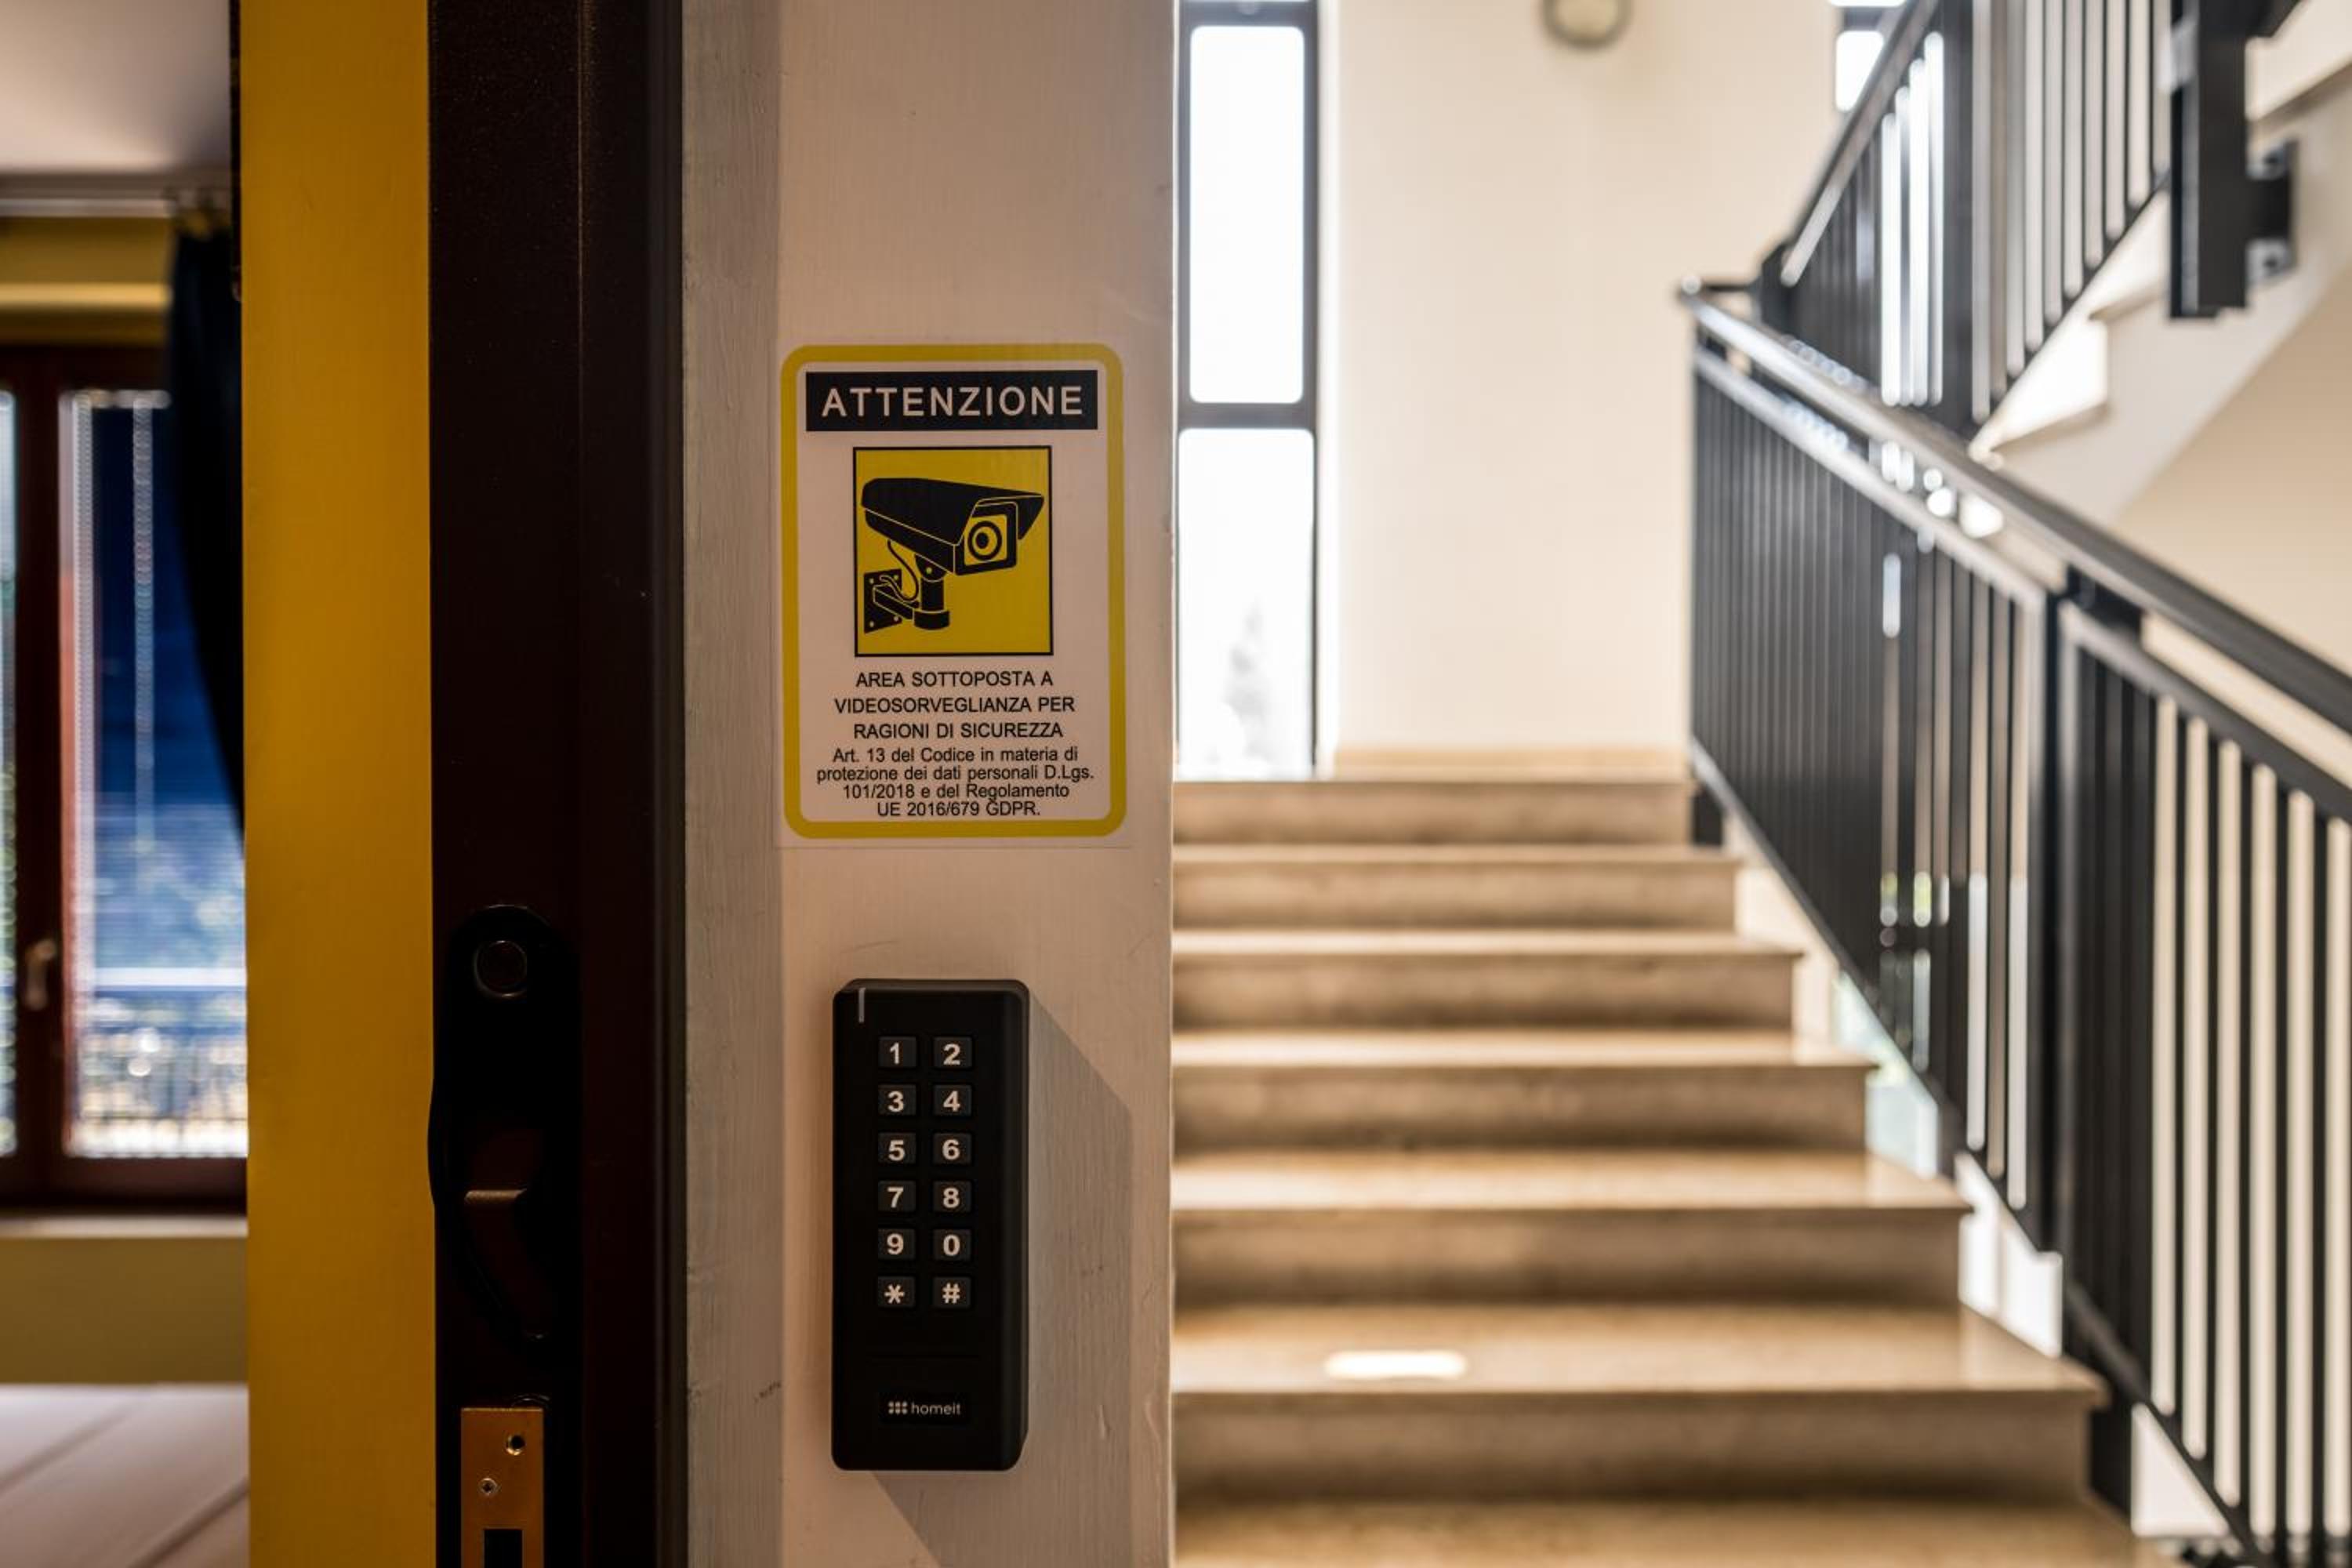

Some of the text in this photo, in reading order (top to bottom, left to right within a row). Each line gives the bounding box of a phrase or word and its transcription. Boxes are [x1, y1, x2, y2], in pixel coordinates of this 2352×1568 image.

[822, 385, 1083, 417] ATTENZIONE
[855, 670, 1054, 688] AREA SOTTOPOSTA A
[834, 696, 1076, 714] VIDEOSORVEGLIANZA PER
[854, 721, 1064, 739] RAGIONI DI SICUREZZA
[832, 746, 1078, 763] Art. 13 del Codice in materia di
[817, 764, 1094, 785] protezione dei dati personali D.Lgs.
[843, 783, 1070, 802] 101/2018 e del Regolamento
[877, 800, 1040, 817] UE 2016/679 GDPR.
[890, 1042, 960, 1065] 1 2
[887, 1091, 960, 1112] 3 4
[888, 1138, 960, 1161] 5 6
[887, 1186, 960, 1208] 7 8
[887, 1233, 960, 1257] 9 0
[942, 1283, 960, 1304] #
[911, 1401, 960, 1415] homeit
